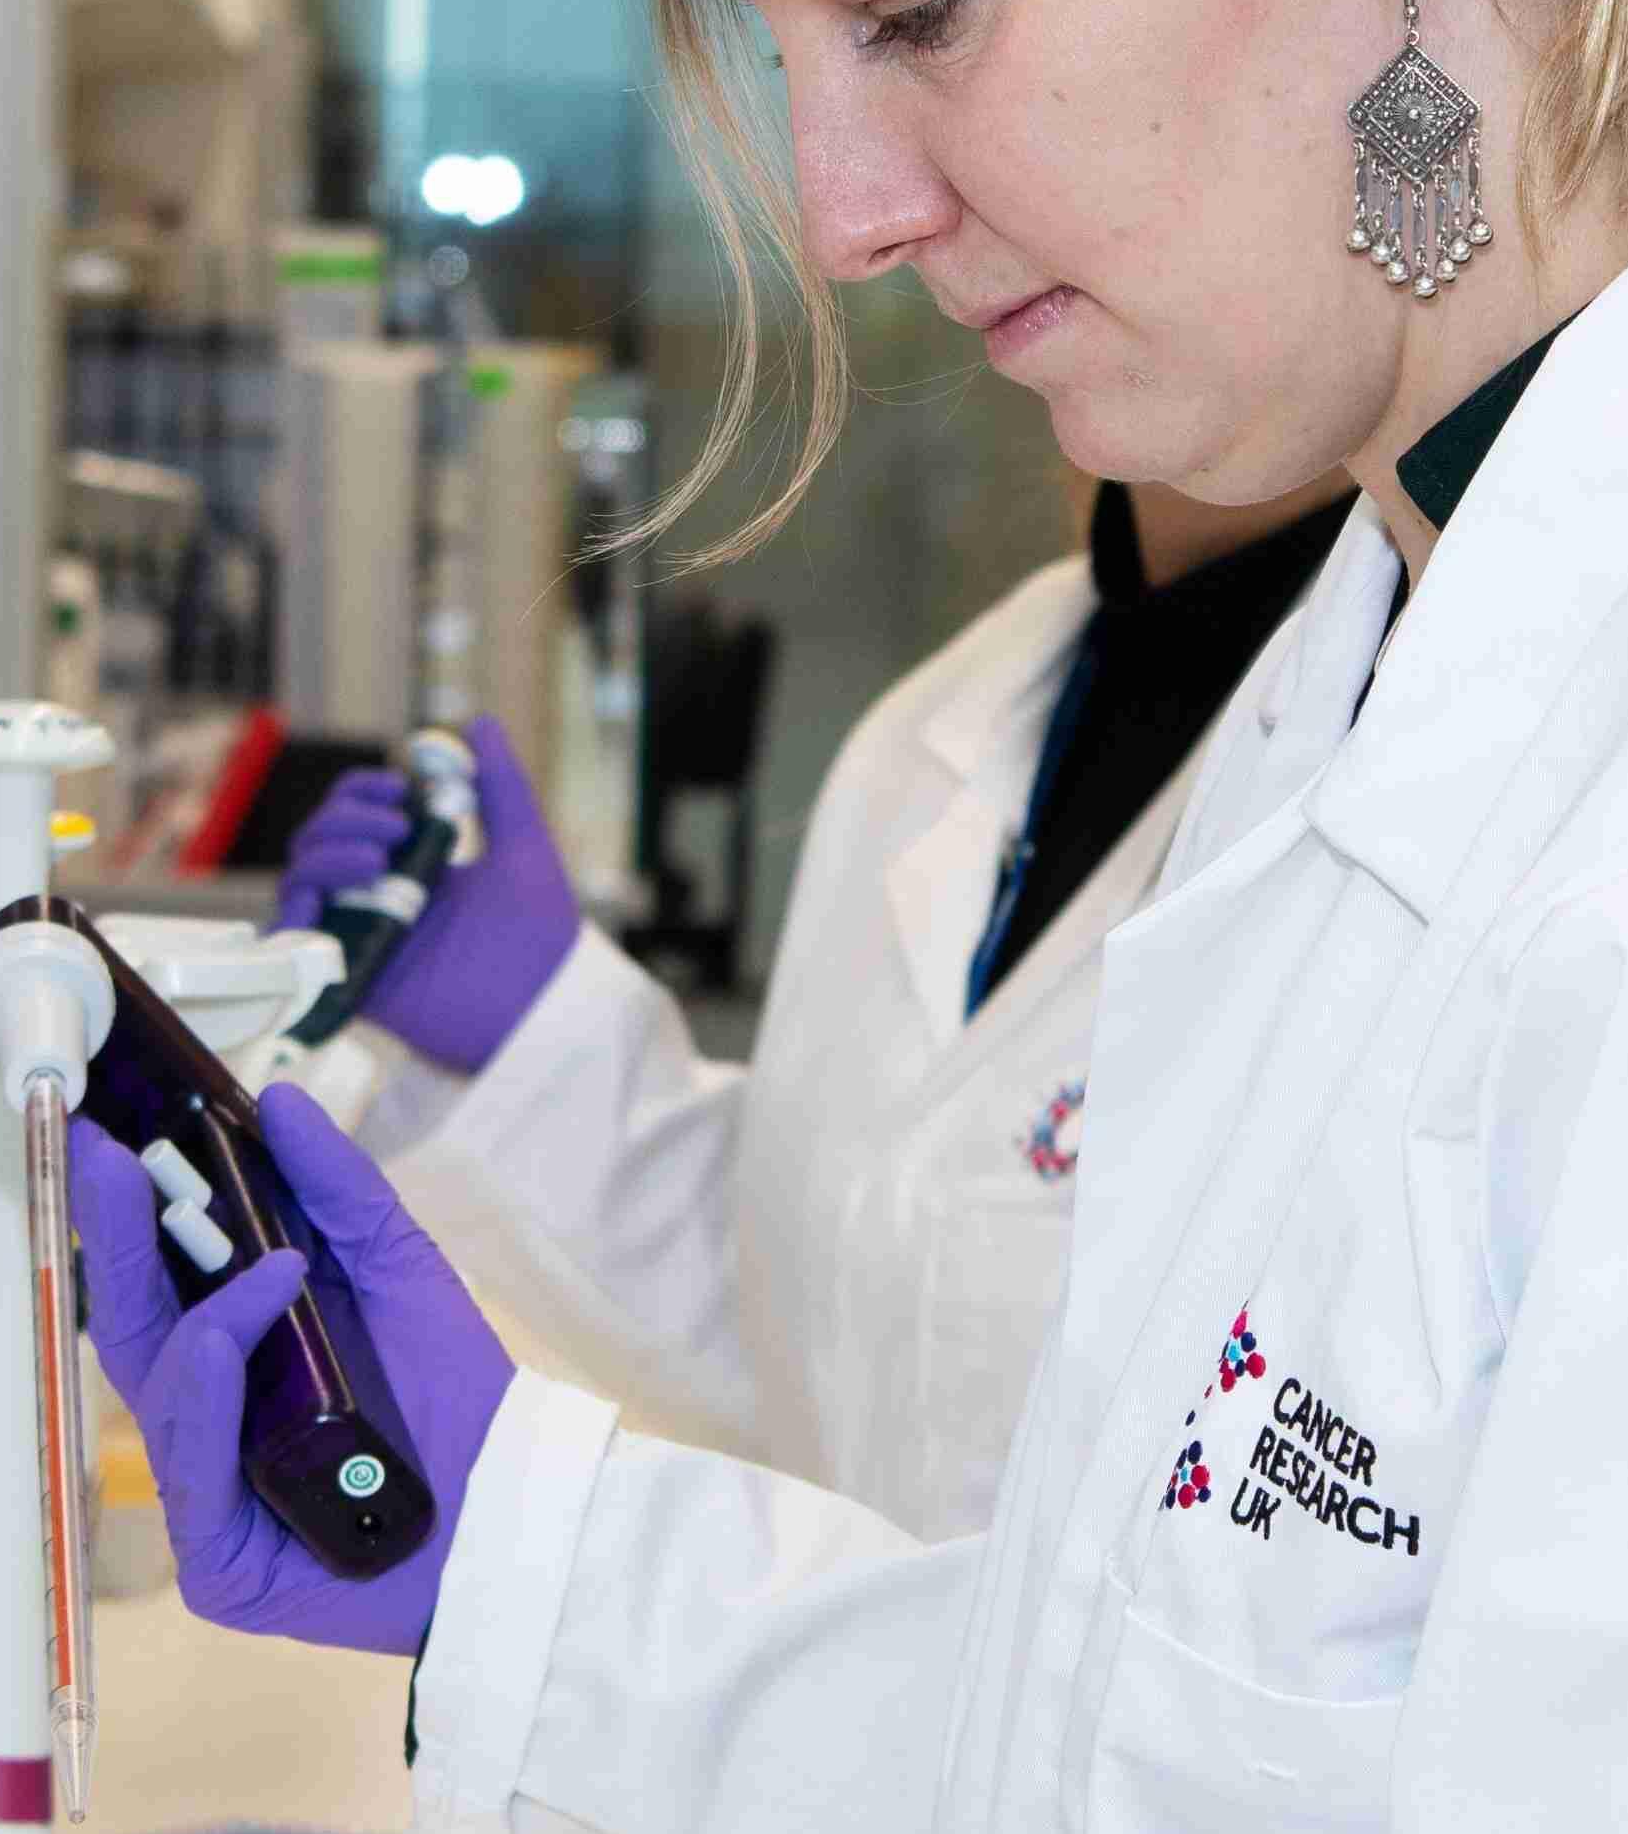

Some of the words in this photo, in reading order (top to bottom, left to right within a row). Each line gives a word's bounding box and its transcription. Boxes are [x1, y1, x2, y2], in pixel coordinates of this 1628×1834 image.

[1273, 1377, 1377, 1487] CANCER
[1230, 1476, 1282, 1541] UK
[1249, 1424, 1421, 1556] RESEARCH
